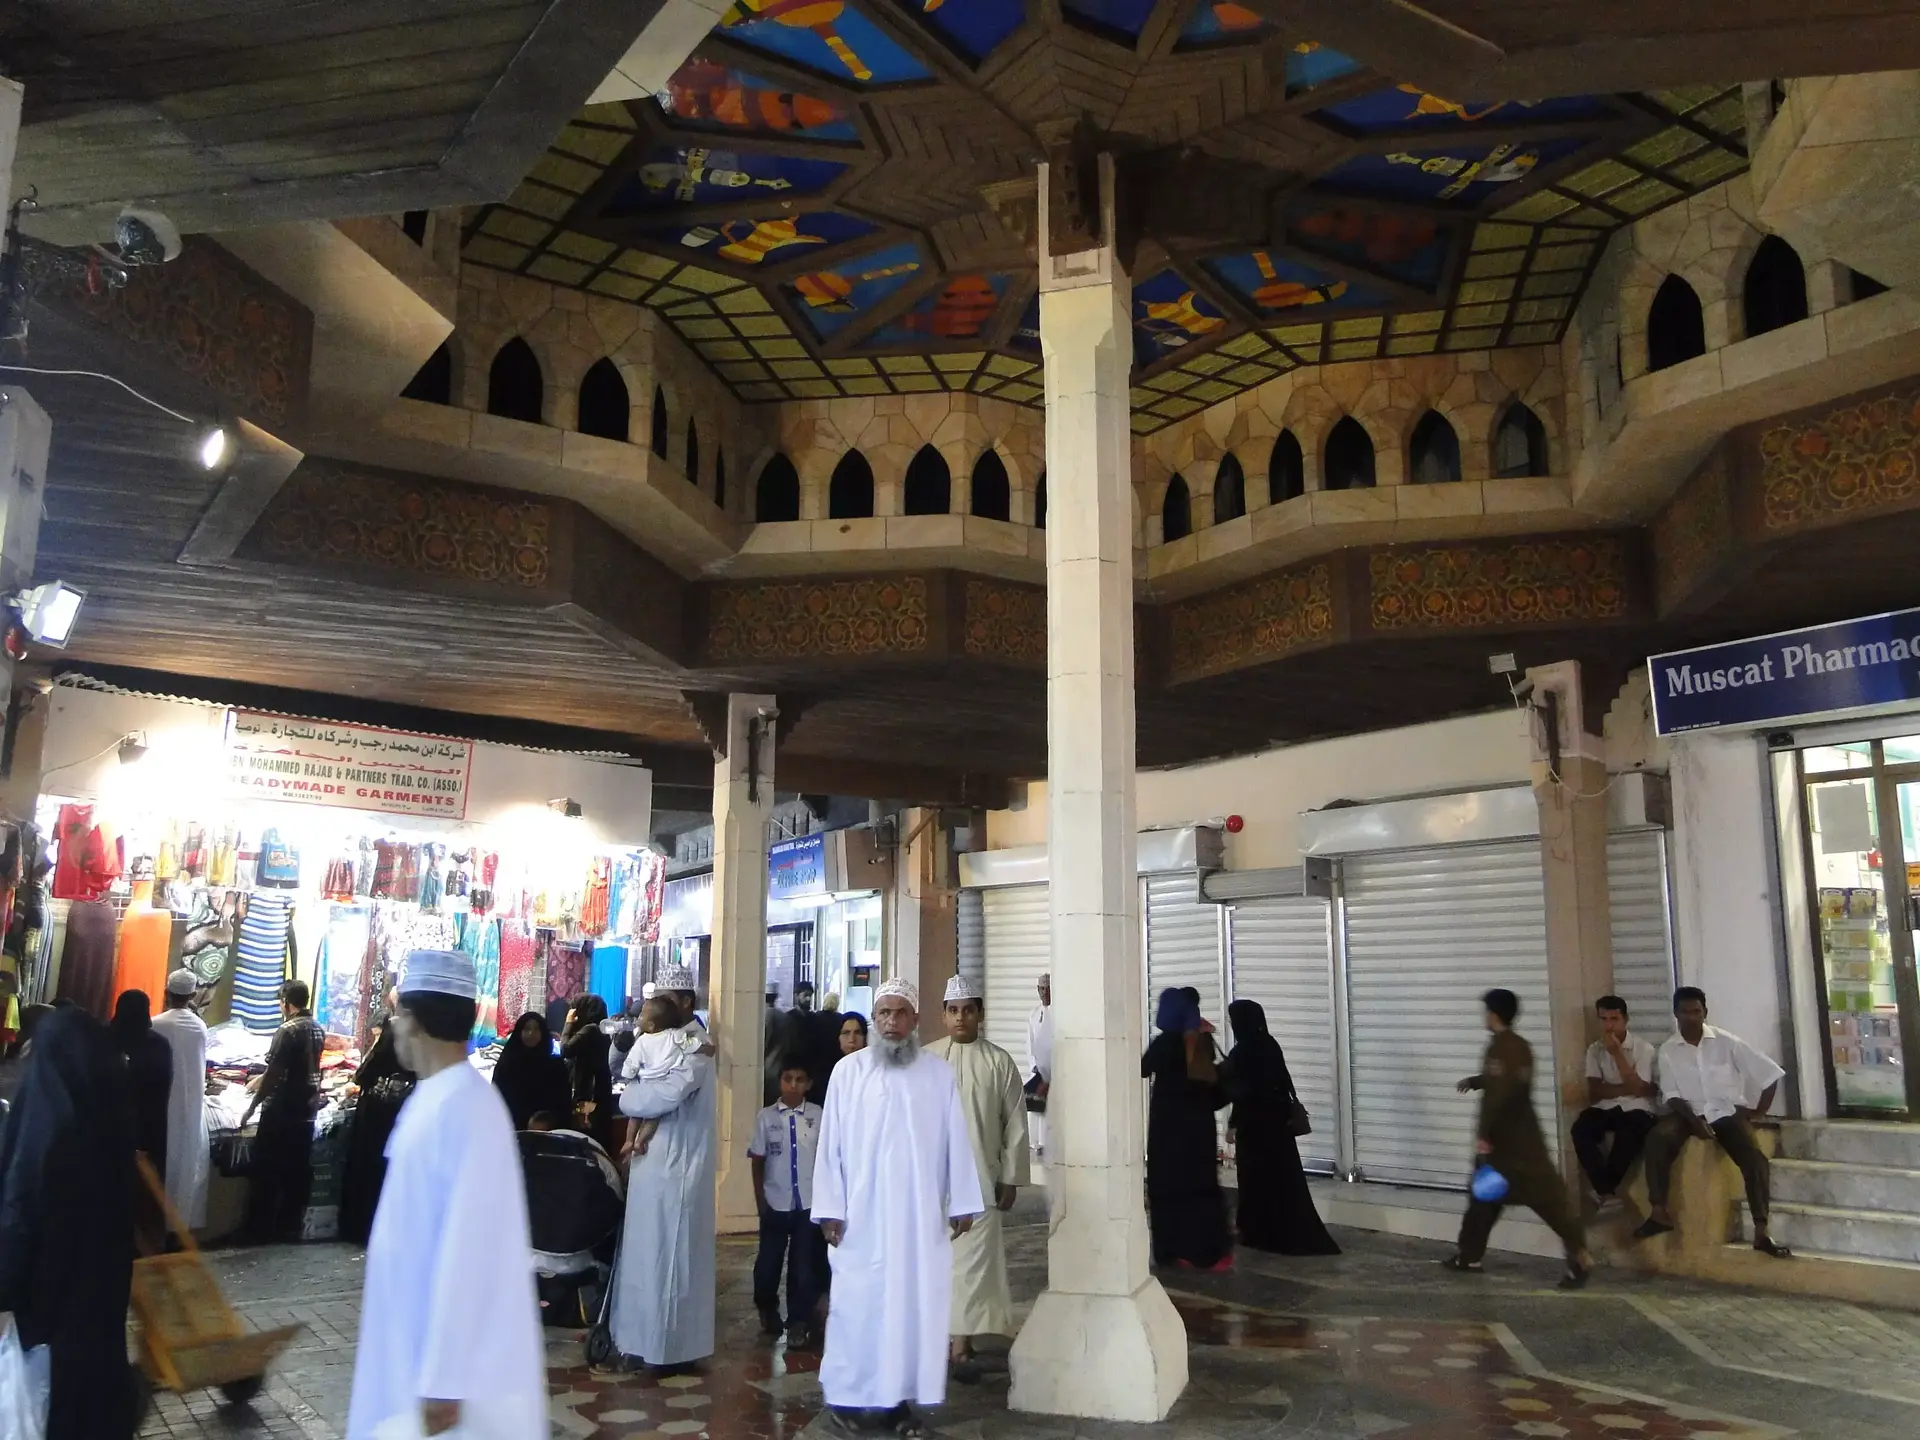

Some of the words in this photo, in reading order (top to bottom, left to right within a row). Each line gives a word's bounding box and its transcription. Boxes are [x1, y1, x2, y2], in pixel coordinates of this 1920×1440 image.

[1666, 654, 1775, 698] Muscat
[271, 723, 316, 741] للتجارة
[317, 730, 358, 749] وشركاه
[360, 739, 387, 752] رجب
[389, 741, 420, 755] محمد
[421, 746, 437, 758] ابن
[438, 745, 466, 760] شركة
[249, 756, 300, 775] MOHAMMED
[304, 763, 333, 779] RAJAB
[335, 767, 342, 780] &
[345, 767, 387, 785] PARTNERS
[391, 773, 415, 788] TRAD.
[417, 776, 431, 790] CO.
[433, 777, 463, 794] (ASSO.)
[359, 761, 462, 775] الملابس
[356, 788, 456, 807] GARMENTS
